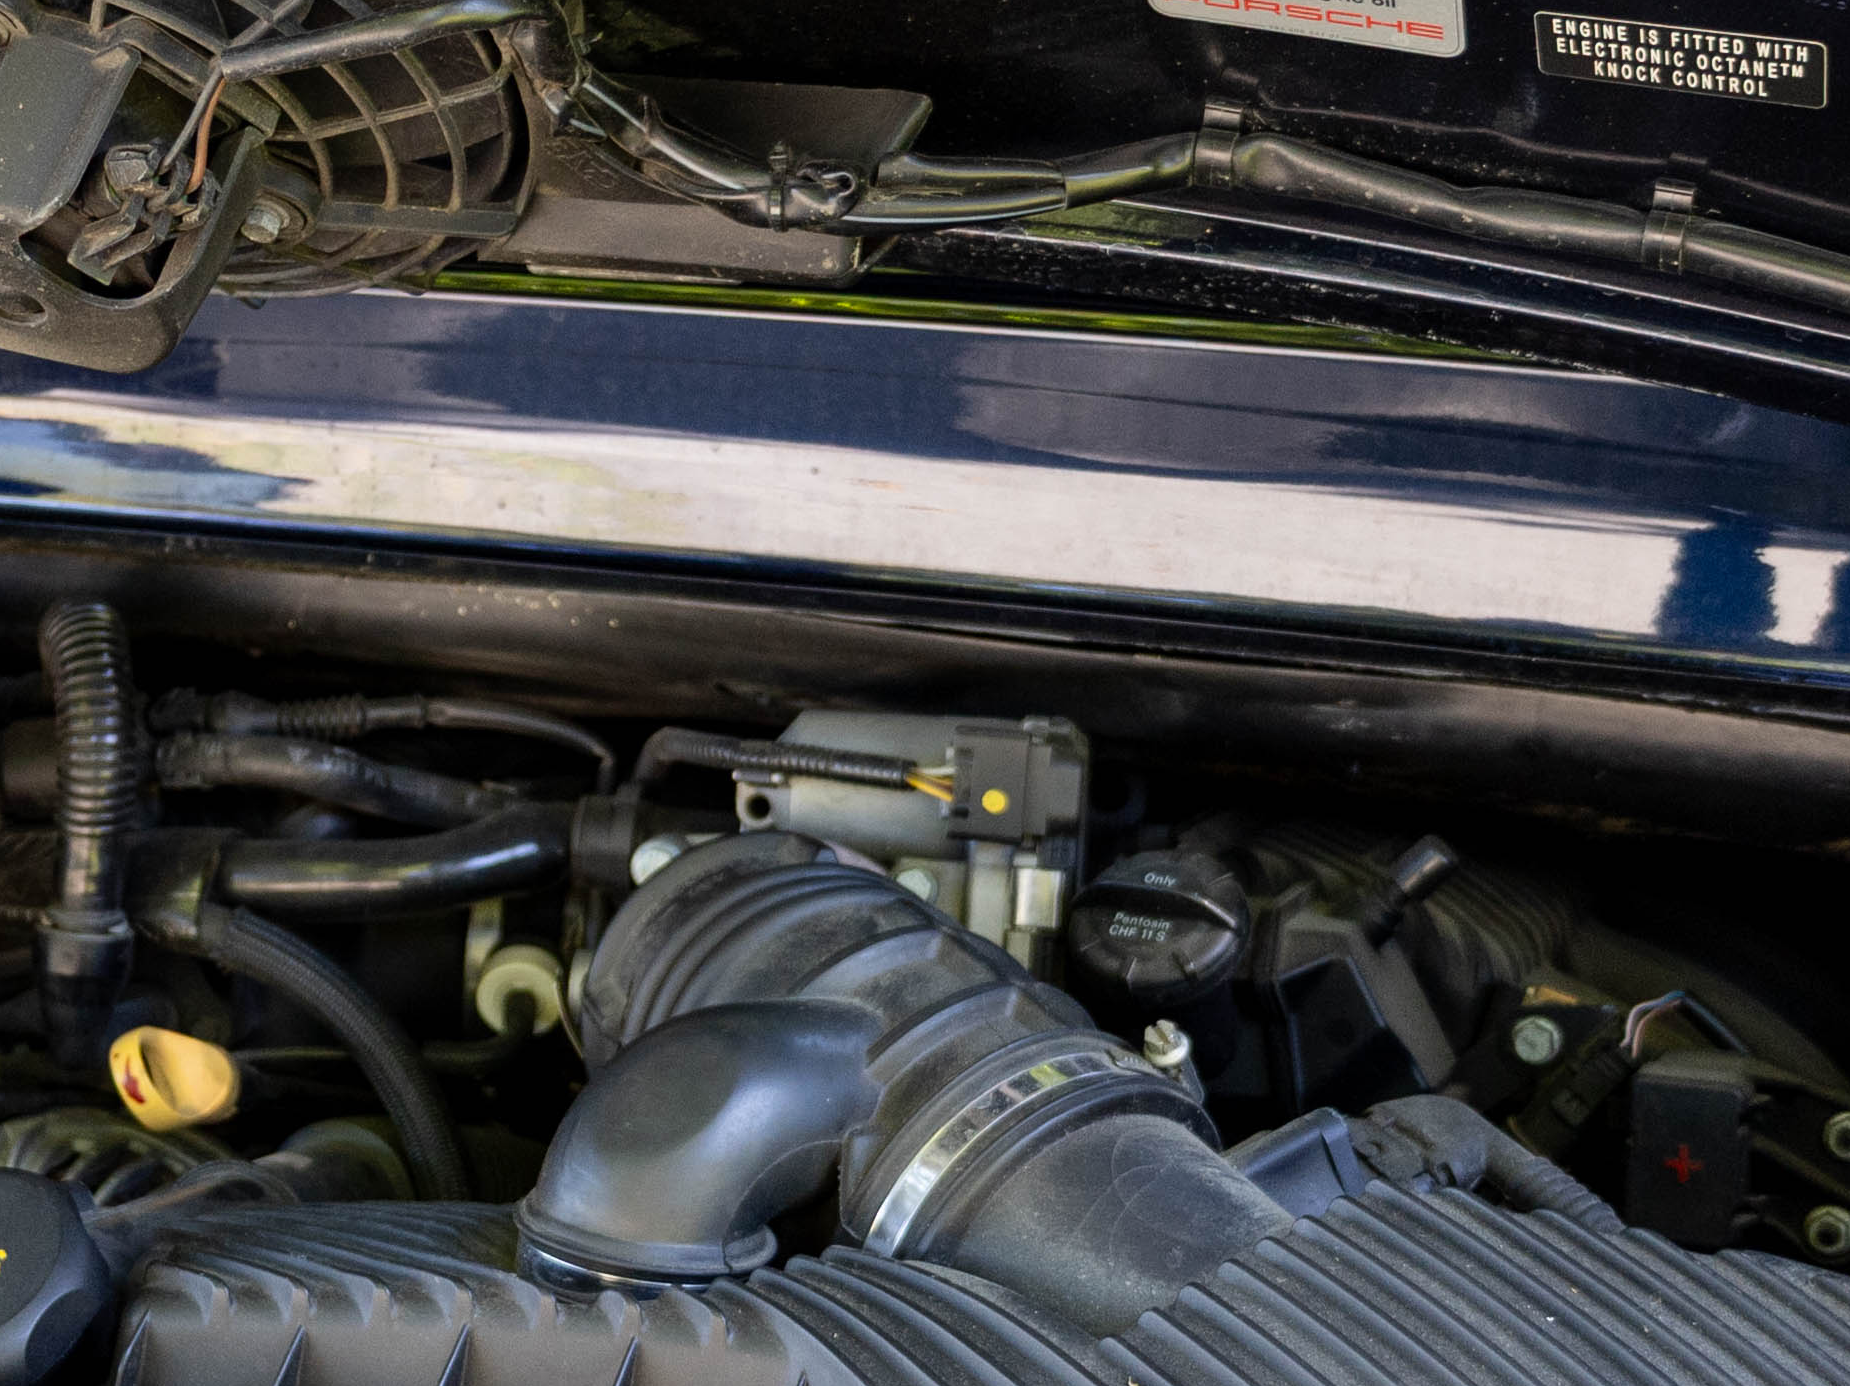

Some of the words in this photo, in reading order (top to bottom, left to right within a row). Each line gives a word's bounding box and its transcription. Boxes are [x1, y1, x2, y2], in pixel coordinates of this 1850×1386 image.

[1552, 18, 1628, 42] ENGINE
[1640, 28, 1660, 45] IS
[1671, 31, 1745, 55] FITTED
[1756, 41, 1808, 62] WITH
[1556, 37, 1685, 67] ELECTRONIC
[1594, 60, 1661, 84] KNOCK
[1672, 70, 1768, 97] CONTROL
[1144, 872, 1176, 886] Only
[1109, 925, 1136, 938] CHF
[1141, 929, 1152, 940] 11
[1156, 931, 1166, 942] S
[1114, 912, 1171, 931] Pentosin
